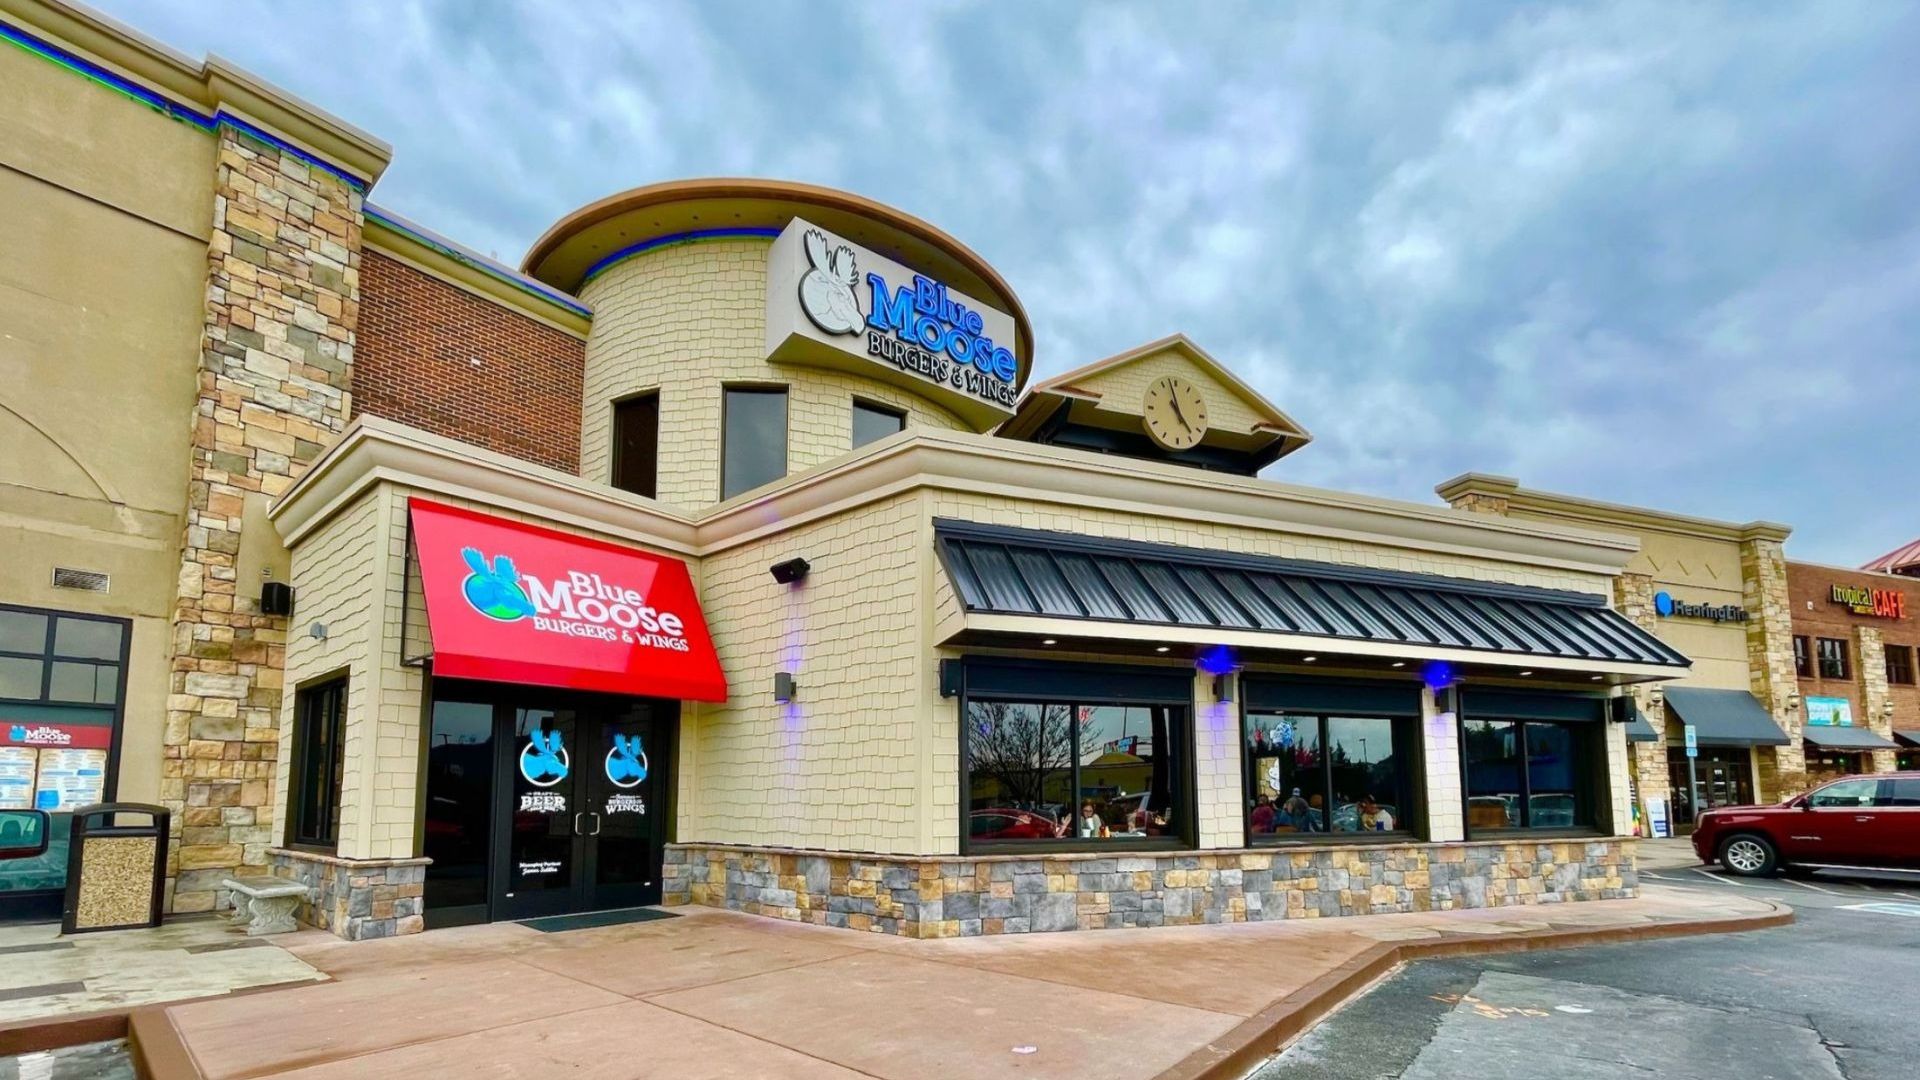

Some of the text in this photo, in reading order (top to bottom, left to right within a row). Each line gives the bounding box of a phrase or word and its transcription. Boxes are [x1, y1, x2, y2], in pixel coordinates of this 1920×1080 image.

[913, 274, 983, 337] Blue
[868, 331, 1017, 407] BURGERS & WINGS
[568, 570, 643, 607] Blue
[1832, 584, 1906, 619] tropical CAFE
[533, 616, 689, 652] BURGERS & WINGS
[520, 795, 566, 811] BEER
[605, 804, 645, 815] WINGS
